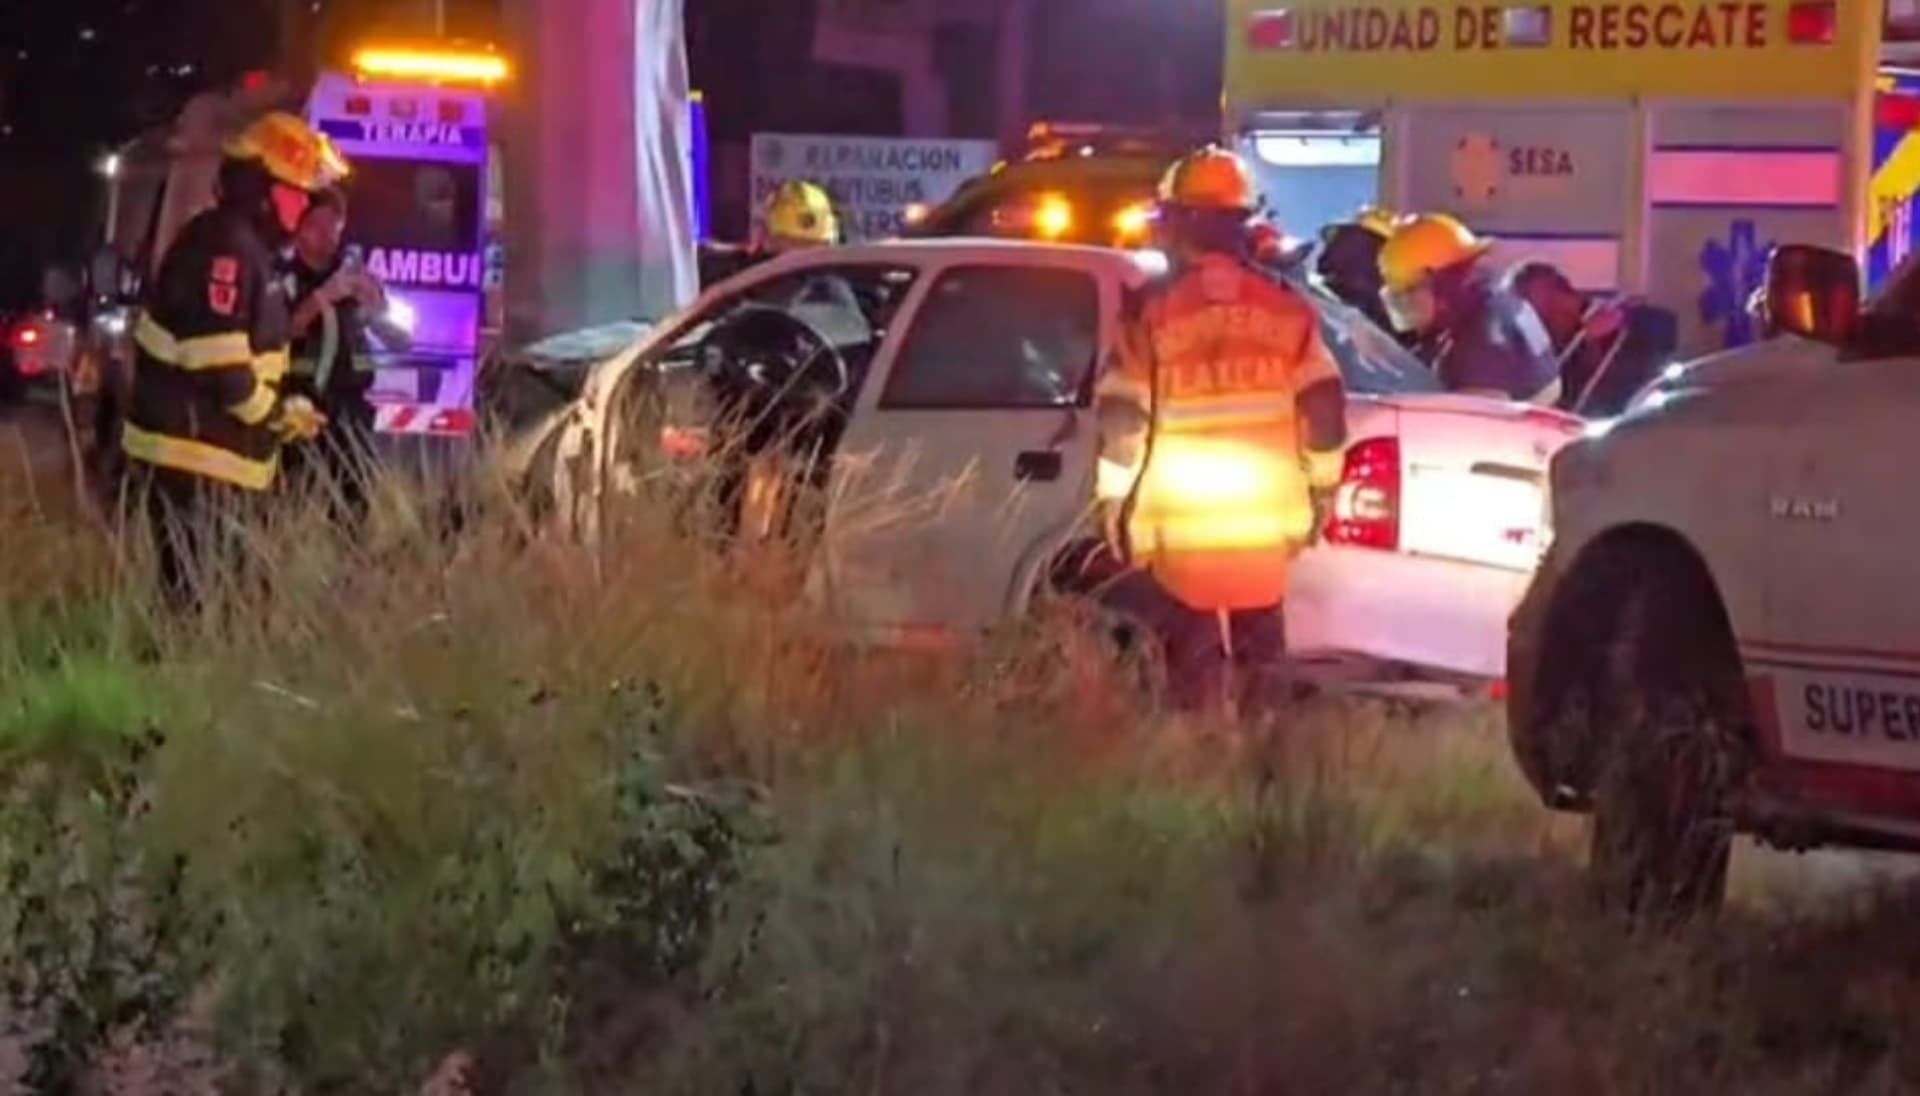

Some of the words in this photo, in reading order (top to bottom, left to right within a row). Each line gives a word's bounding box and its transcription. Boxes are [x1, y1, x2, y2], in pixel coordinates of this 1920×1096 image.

[1300, 7, 1439, 50] UNIDAD
[1455, 7, 1499, 50] DE
[1570, 4, 1766, 49] RESCATE
[362, 121, 463, 144] TERAPIA
[1509, 146, 1574, 175] SESA
